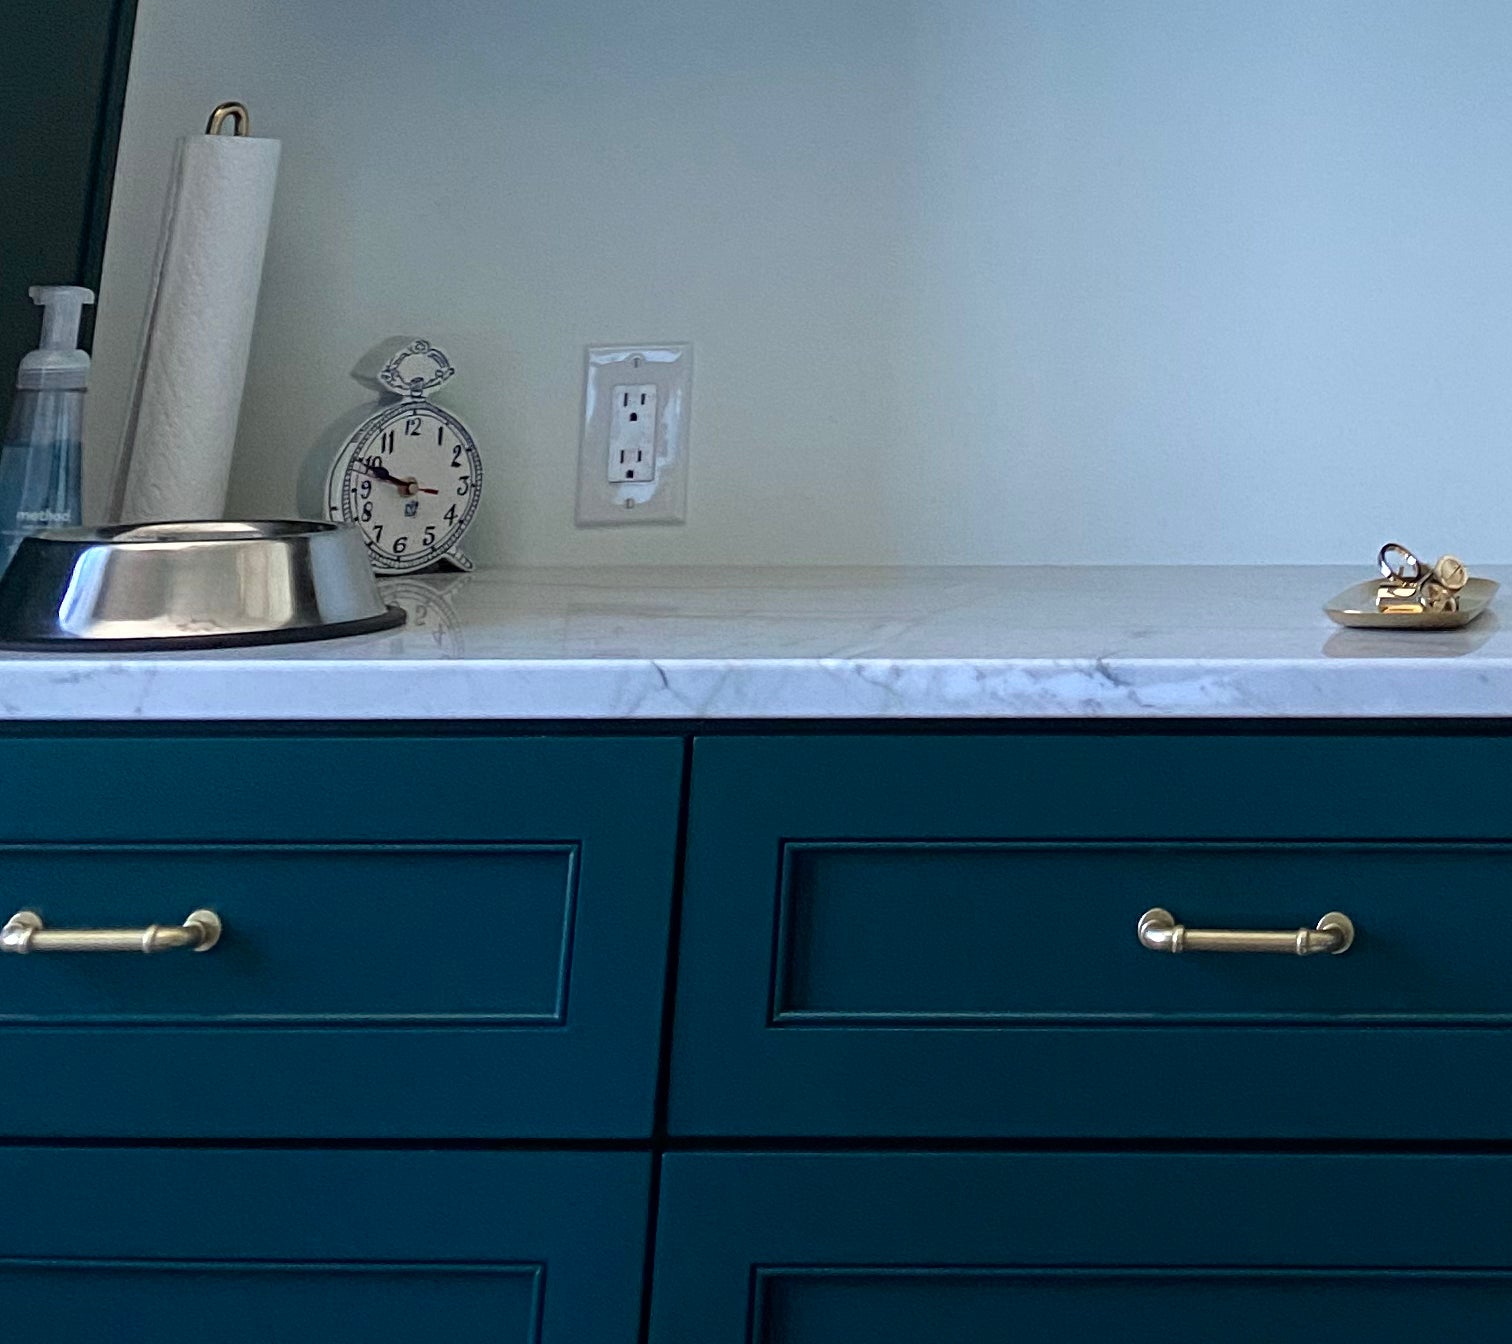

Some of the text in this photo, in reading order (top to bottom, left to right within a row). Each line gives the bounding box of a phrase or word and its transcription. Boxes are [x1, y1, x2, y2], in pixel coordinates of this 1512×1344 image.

[404, 417, 422, 436] 12
[437, 426, 444, 446] 1
[381, 430, 394, 455] 11
[450, 444, 461, 468] 2
[360, 480, 372, 499] 9
[456, 475, 470, 496] 3
[16, 509, 72, 522] method
[361, 501, 373, 522] 8
[443, 504, 459, 527] 4
[373, 525, 384, 542] 7
[422, 526, 436, 546] 5
[393, 537, 408, 553] 6
